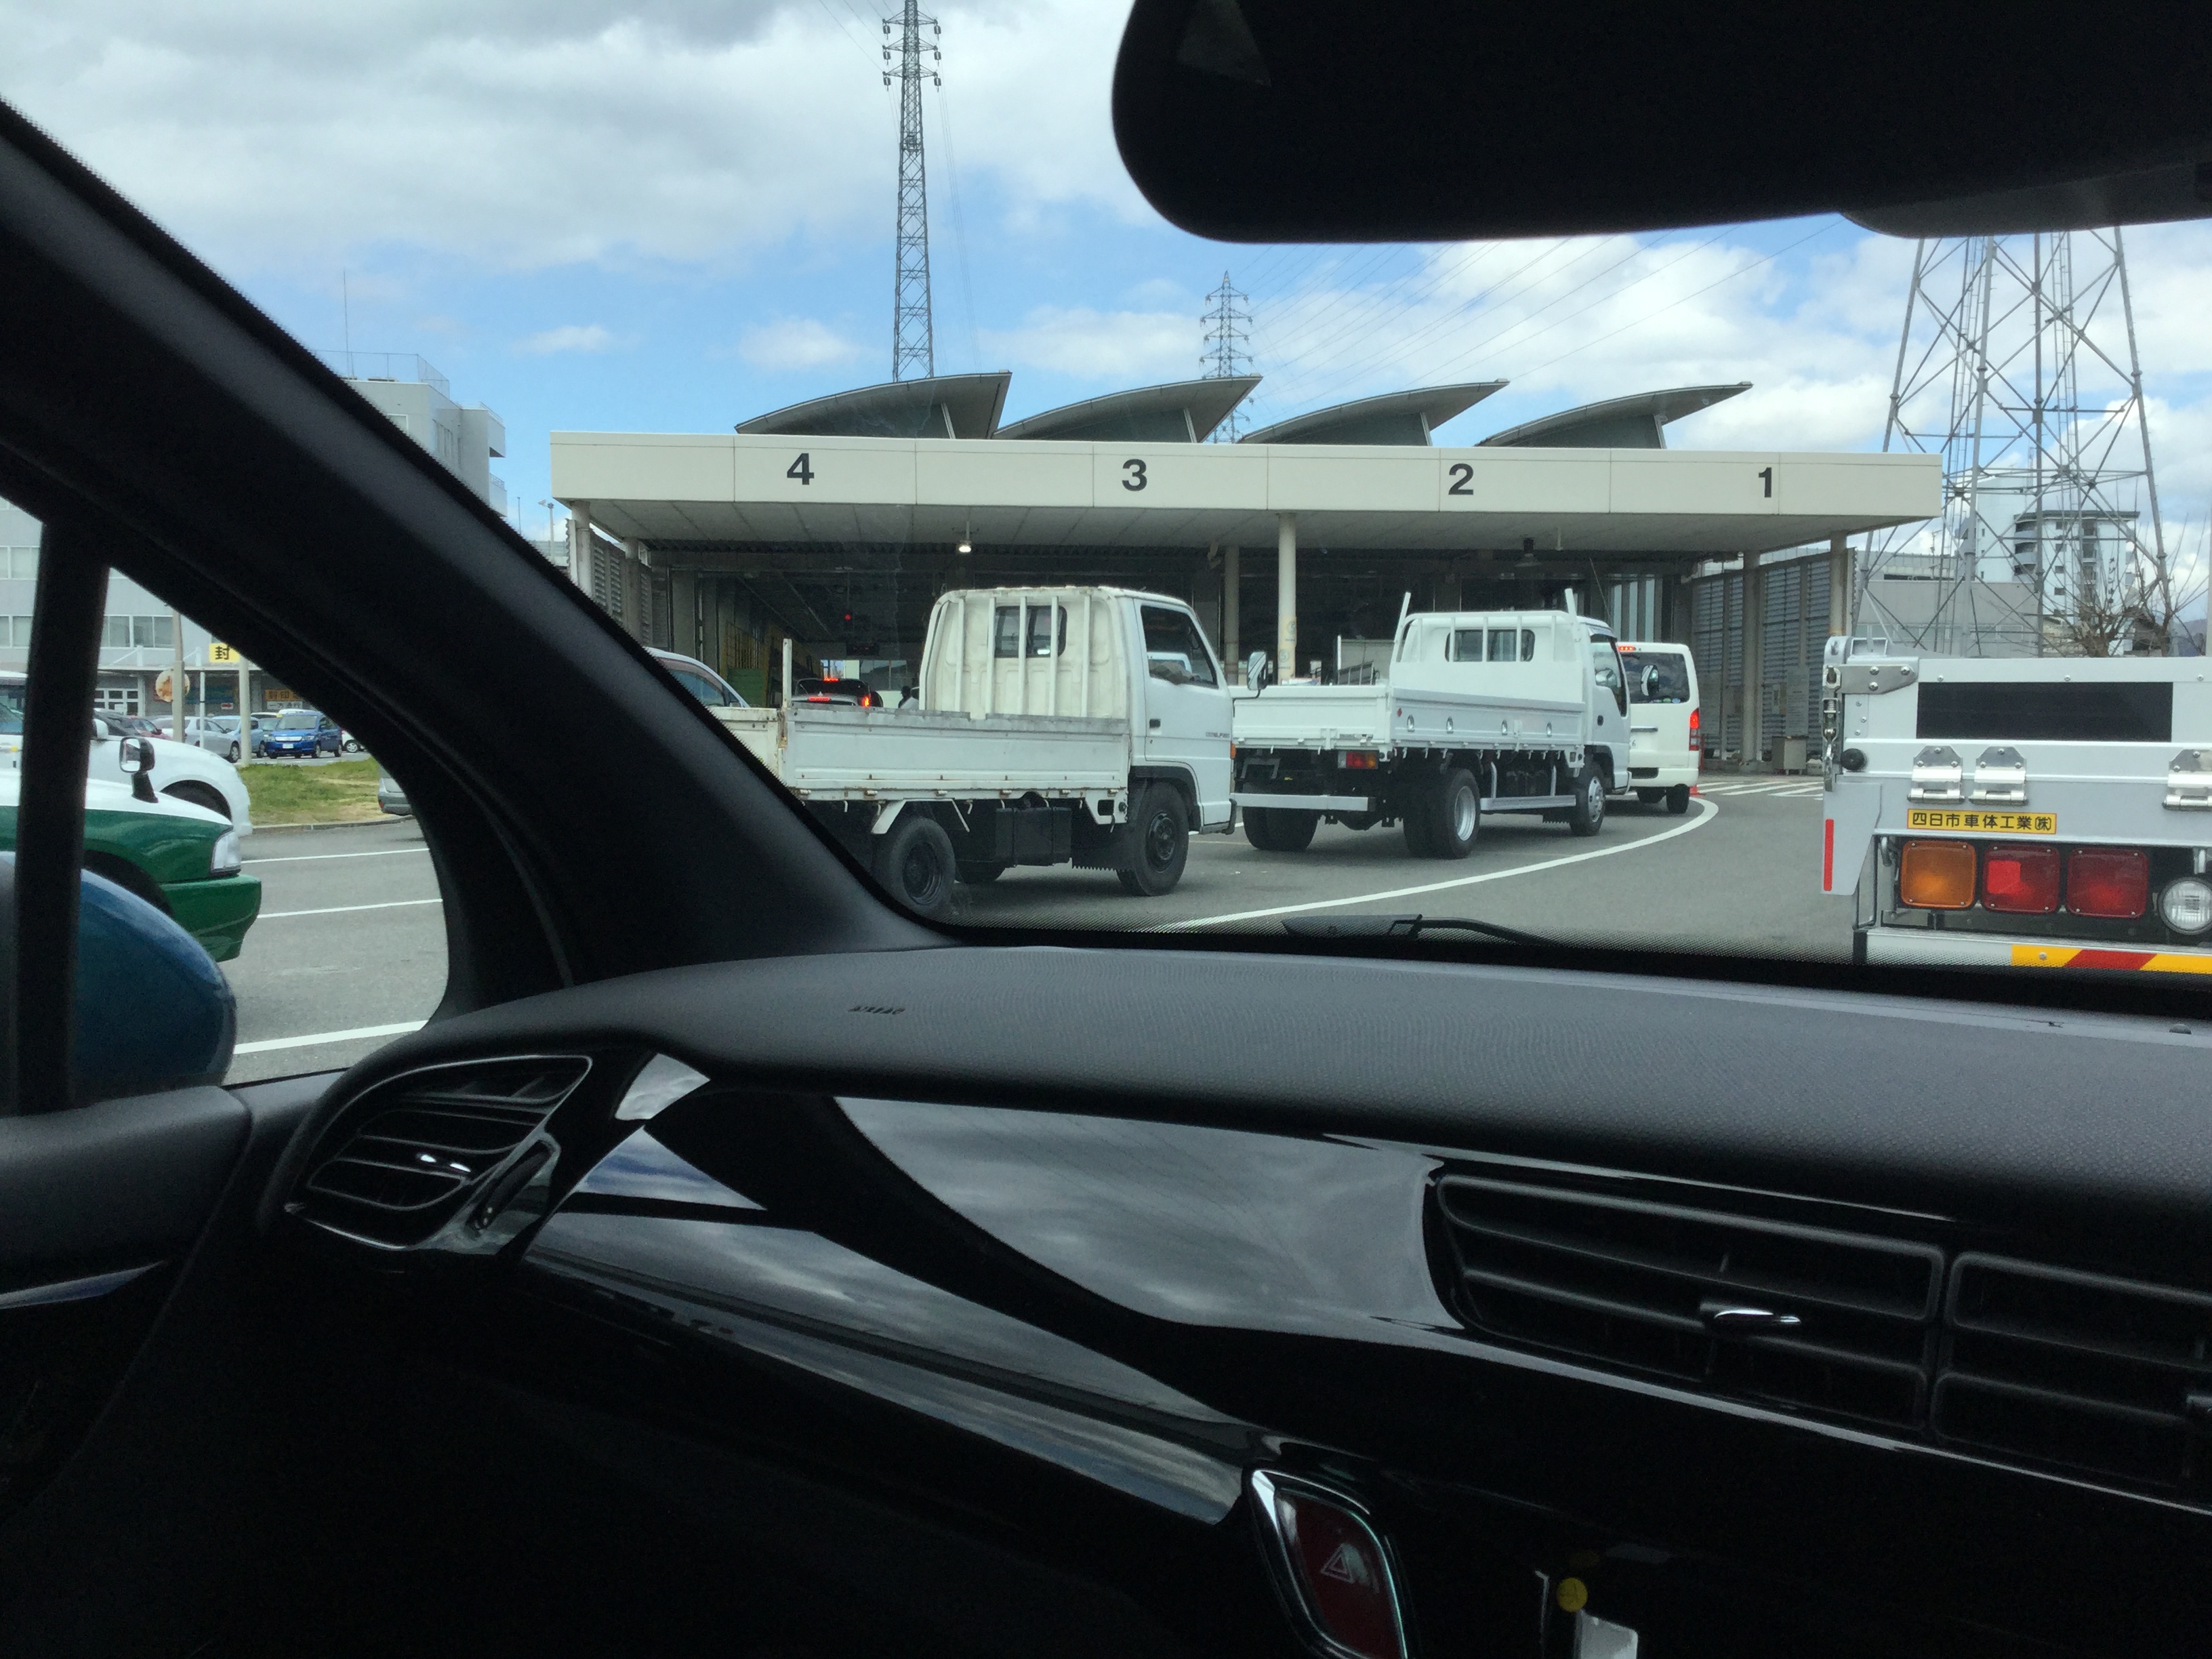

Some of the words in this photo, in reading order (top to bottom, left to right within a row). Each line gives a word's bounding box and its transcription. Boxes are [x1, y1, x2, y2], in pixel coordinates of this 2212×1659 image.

[787, 453, 815, 485] 4
[1122, 459, 1147, 491] 3
[1448, 463, 1474, 495] 2
[1758, 467, 1772, 497] 1
[215, 645, 230, 660] 封
